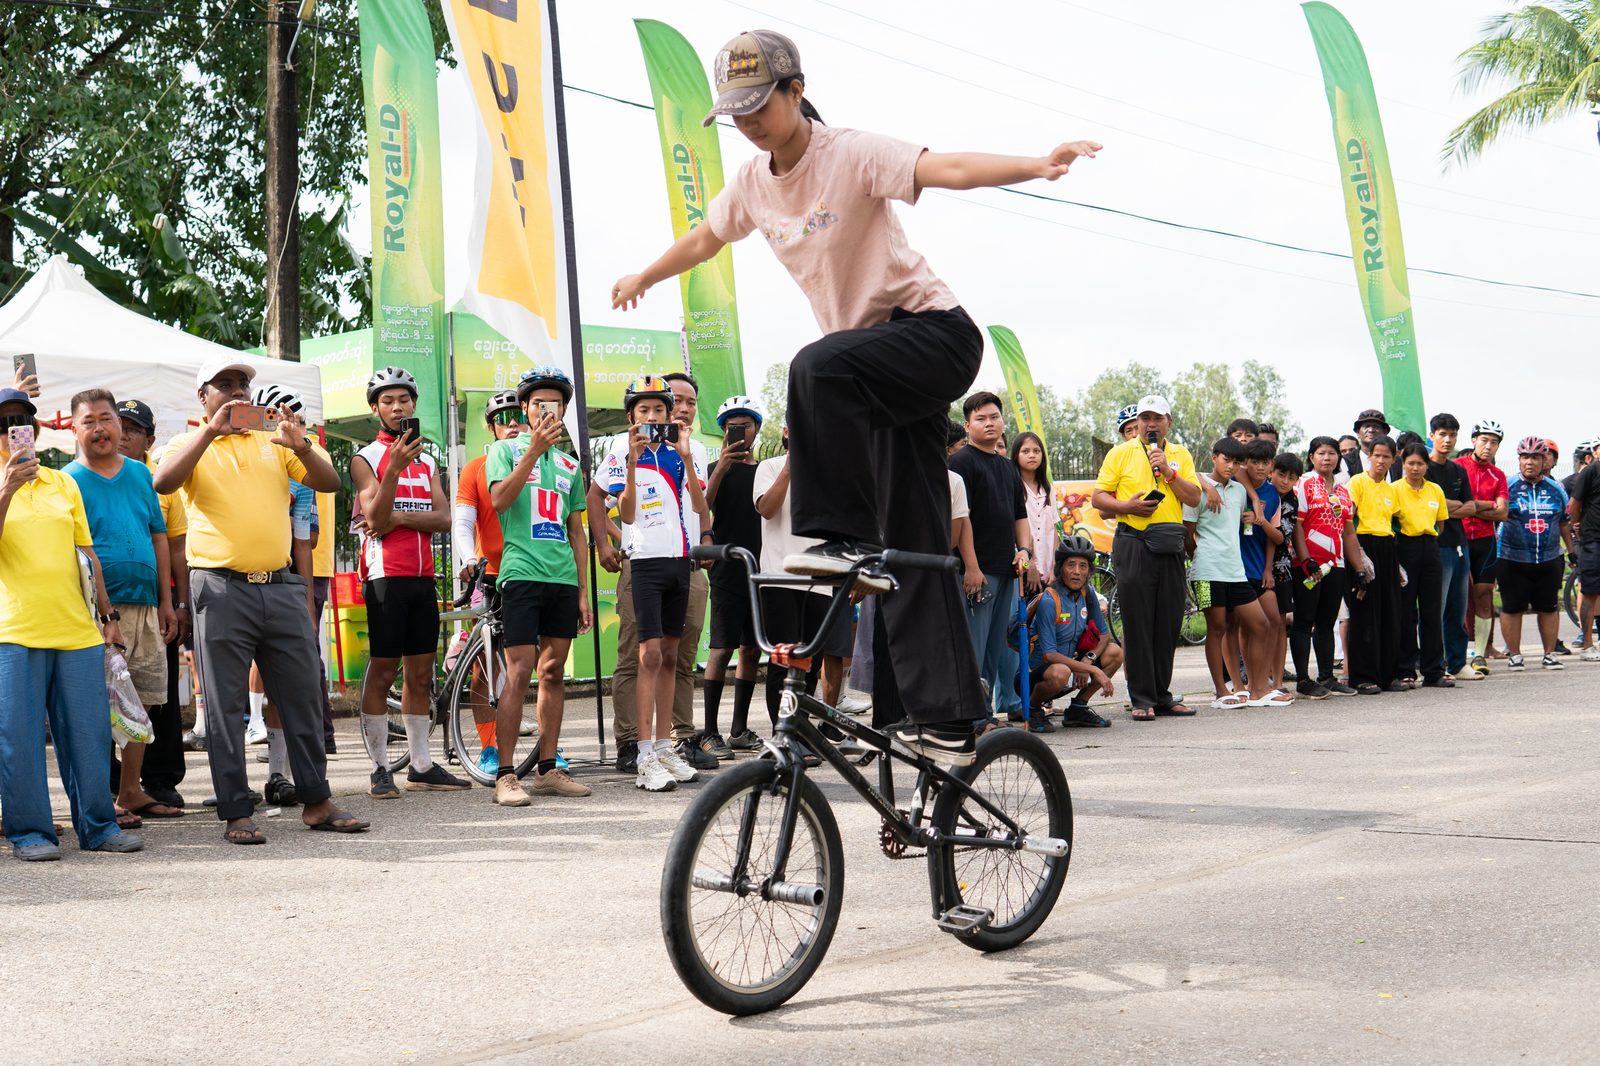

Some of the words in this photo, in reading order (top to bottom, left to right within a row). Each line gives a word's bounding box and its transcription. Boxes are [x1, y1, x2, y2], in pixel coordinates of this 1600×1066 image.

[379, 103, 410, 252] Royal-D
[672, 143, 706, 242] yal-D
[1346, 138, 1384, 273] Royal-D
[117, 716, 140, 739] Royal-D
